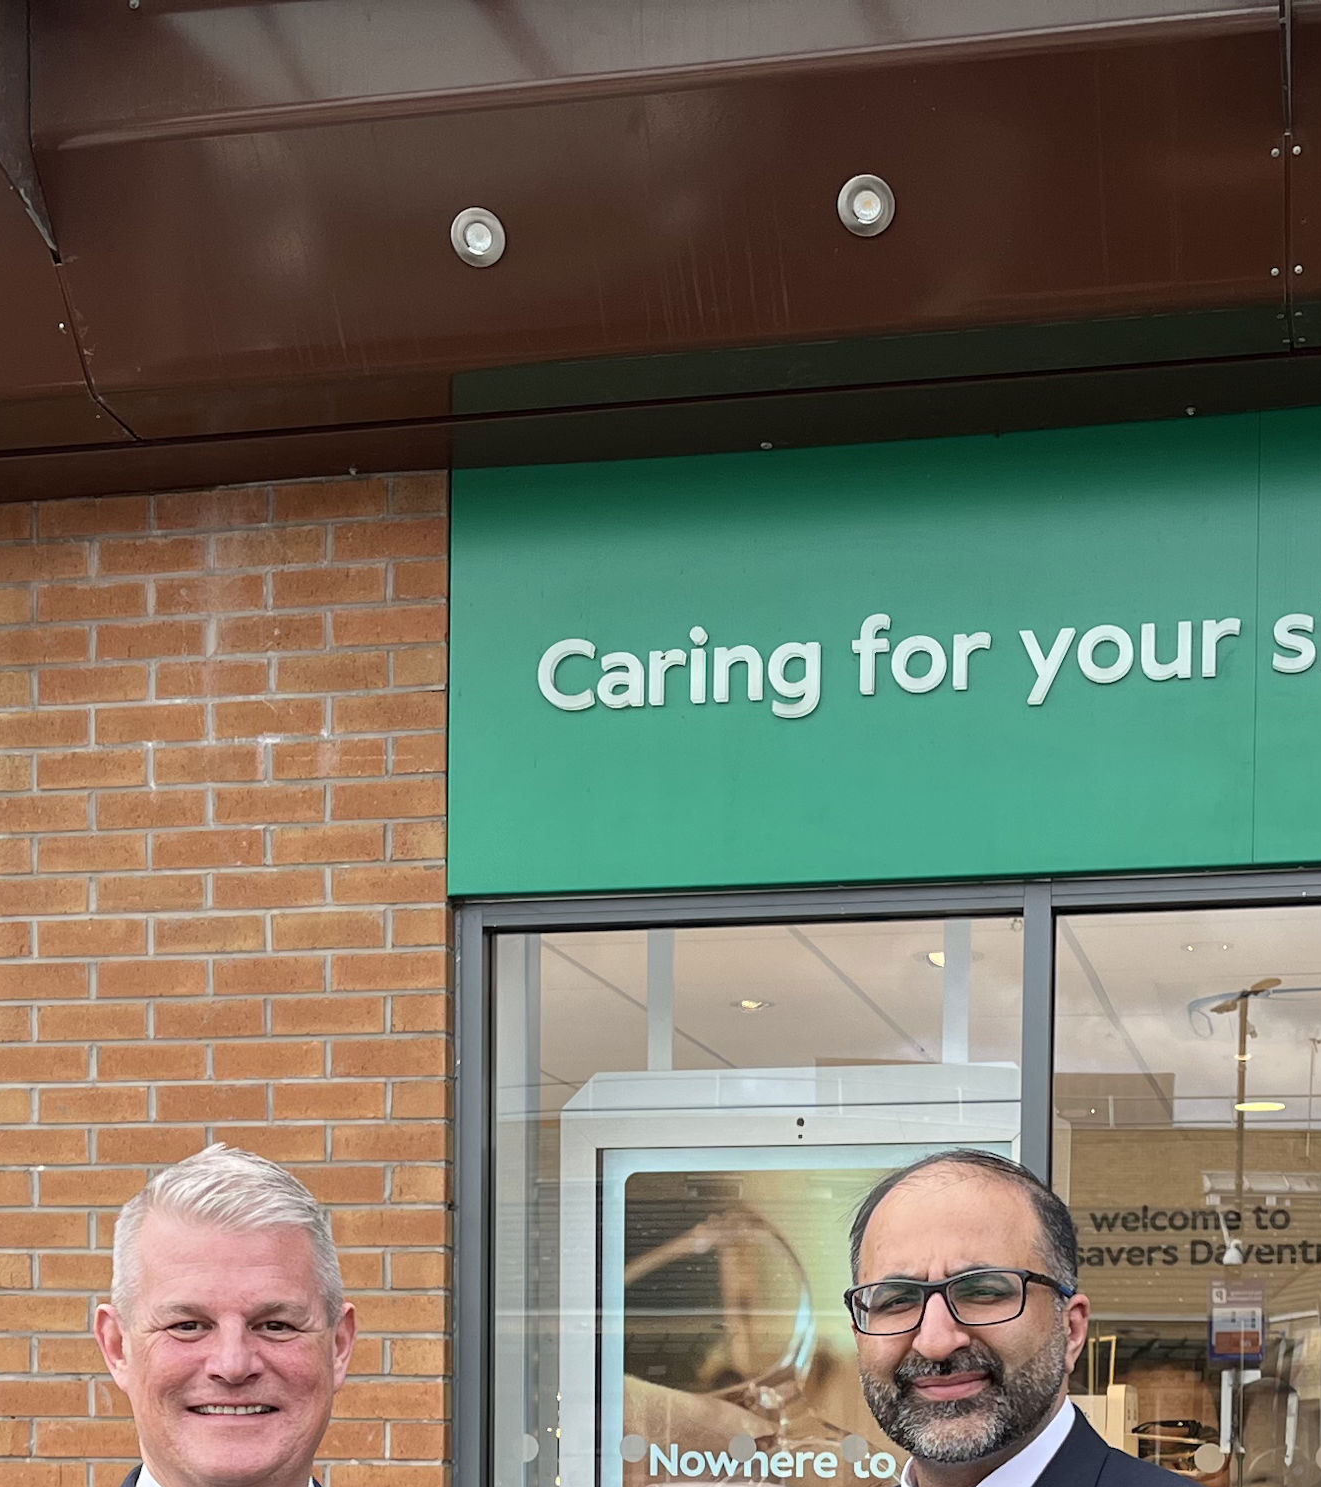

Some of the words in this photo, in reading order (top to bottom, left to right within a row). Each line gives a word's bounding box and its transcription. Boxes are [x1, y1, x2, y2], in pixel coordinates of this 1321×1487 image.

[537, 625, 823, 719] Caring
[852, 613, 992, 696] for
[1018, 616, 1241, 706] your
[1090, 1205, 1242, 1232] welcome
[1253, 1206, 1290, 1231] to
[649, 1443, 838, 1478] Nowhere
[853, 1452, 897, 1479] to
